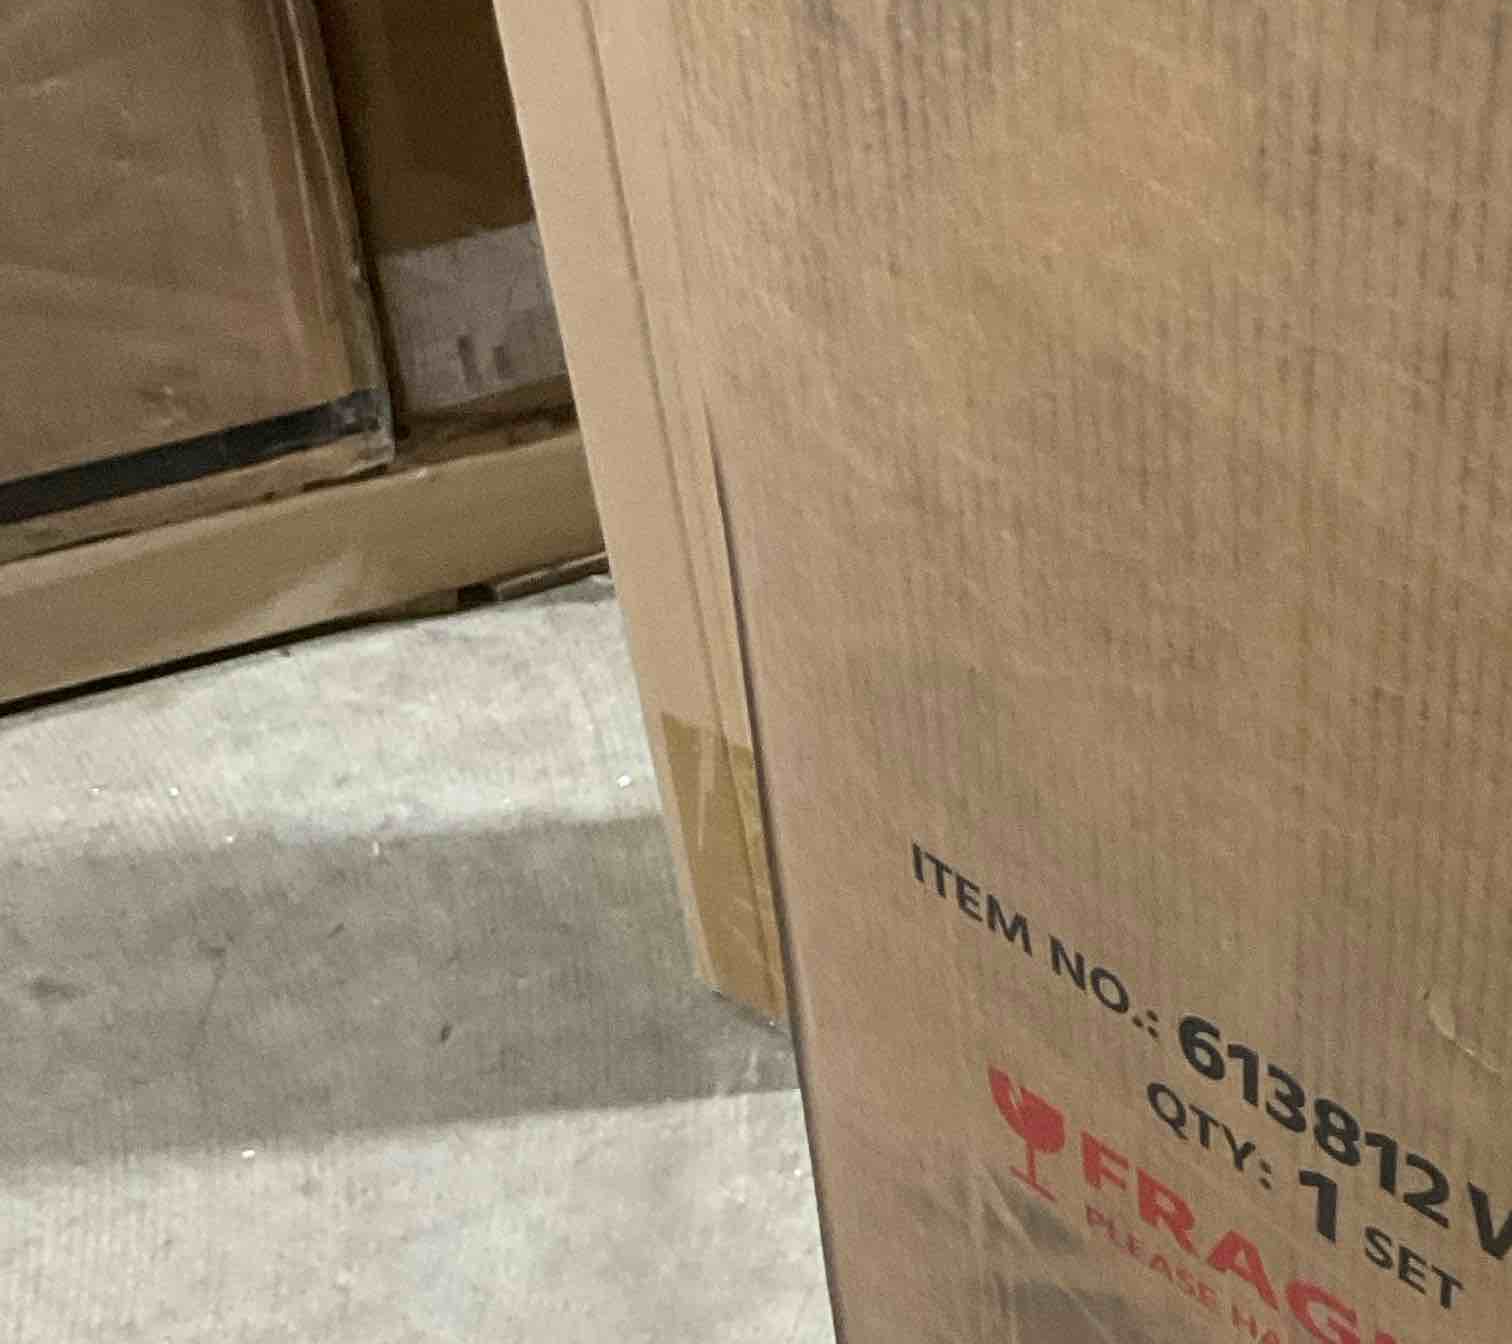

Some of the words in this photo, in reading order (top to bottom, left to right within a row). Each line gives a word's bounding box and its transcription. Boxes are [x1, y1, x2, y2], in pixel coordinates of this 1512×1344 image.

[911, 842, 1034, 958] ITEM
[1048, 934, 1161, 1040] NO.:
[1084, 1202, 1218, 1312] PLEASE
[1146, 1081, 1273, 1190] QTY:
[1298, 1168, 1339, 1245] 1
[1363, 1226, 1464, 1312] SET
